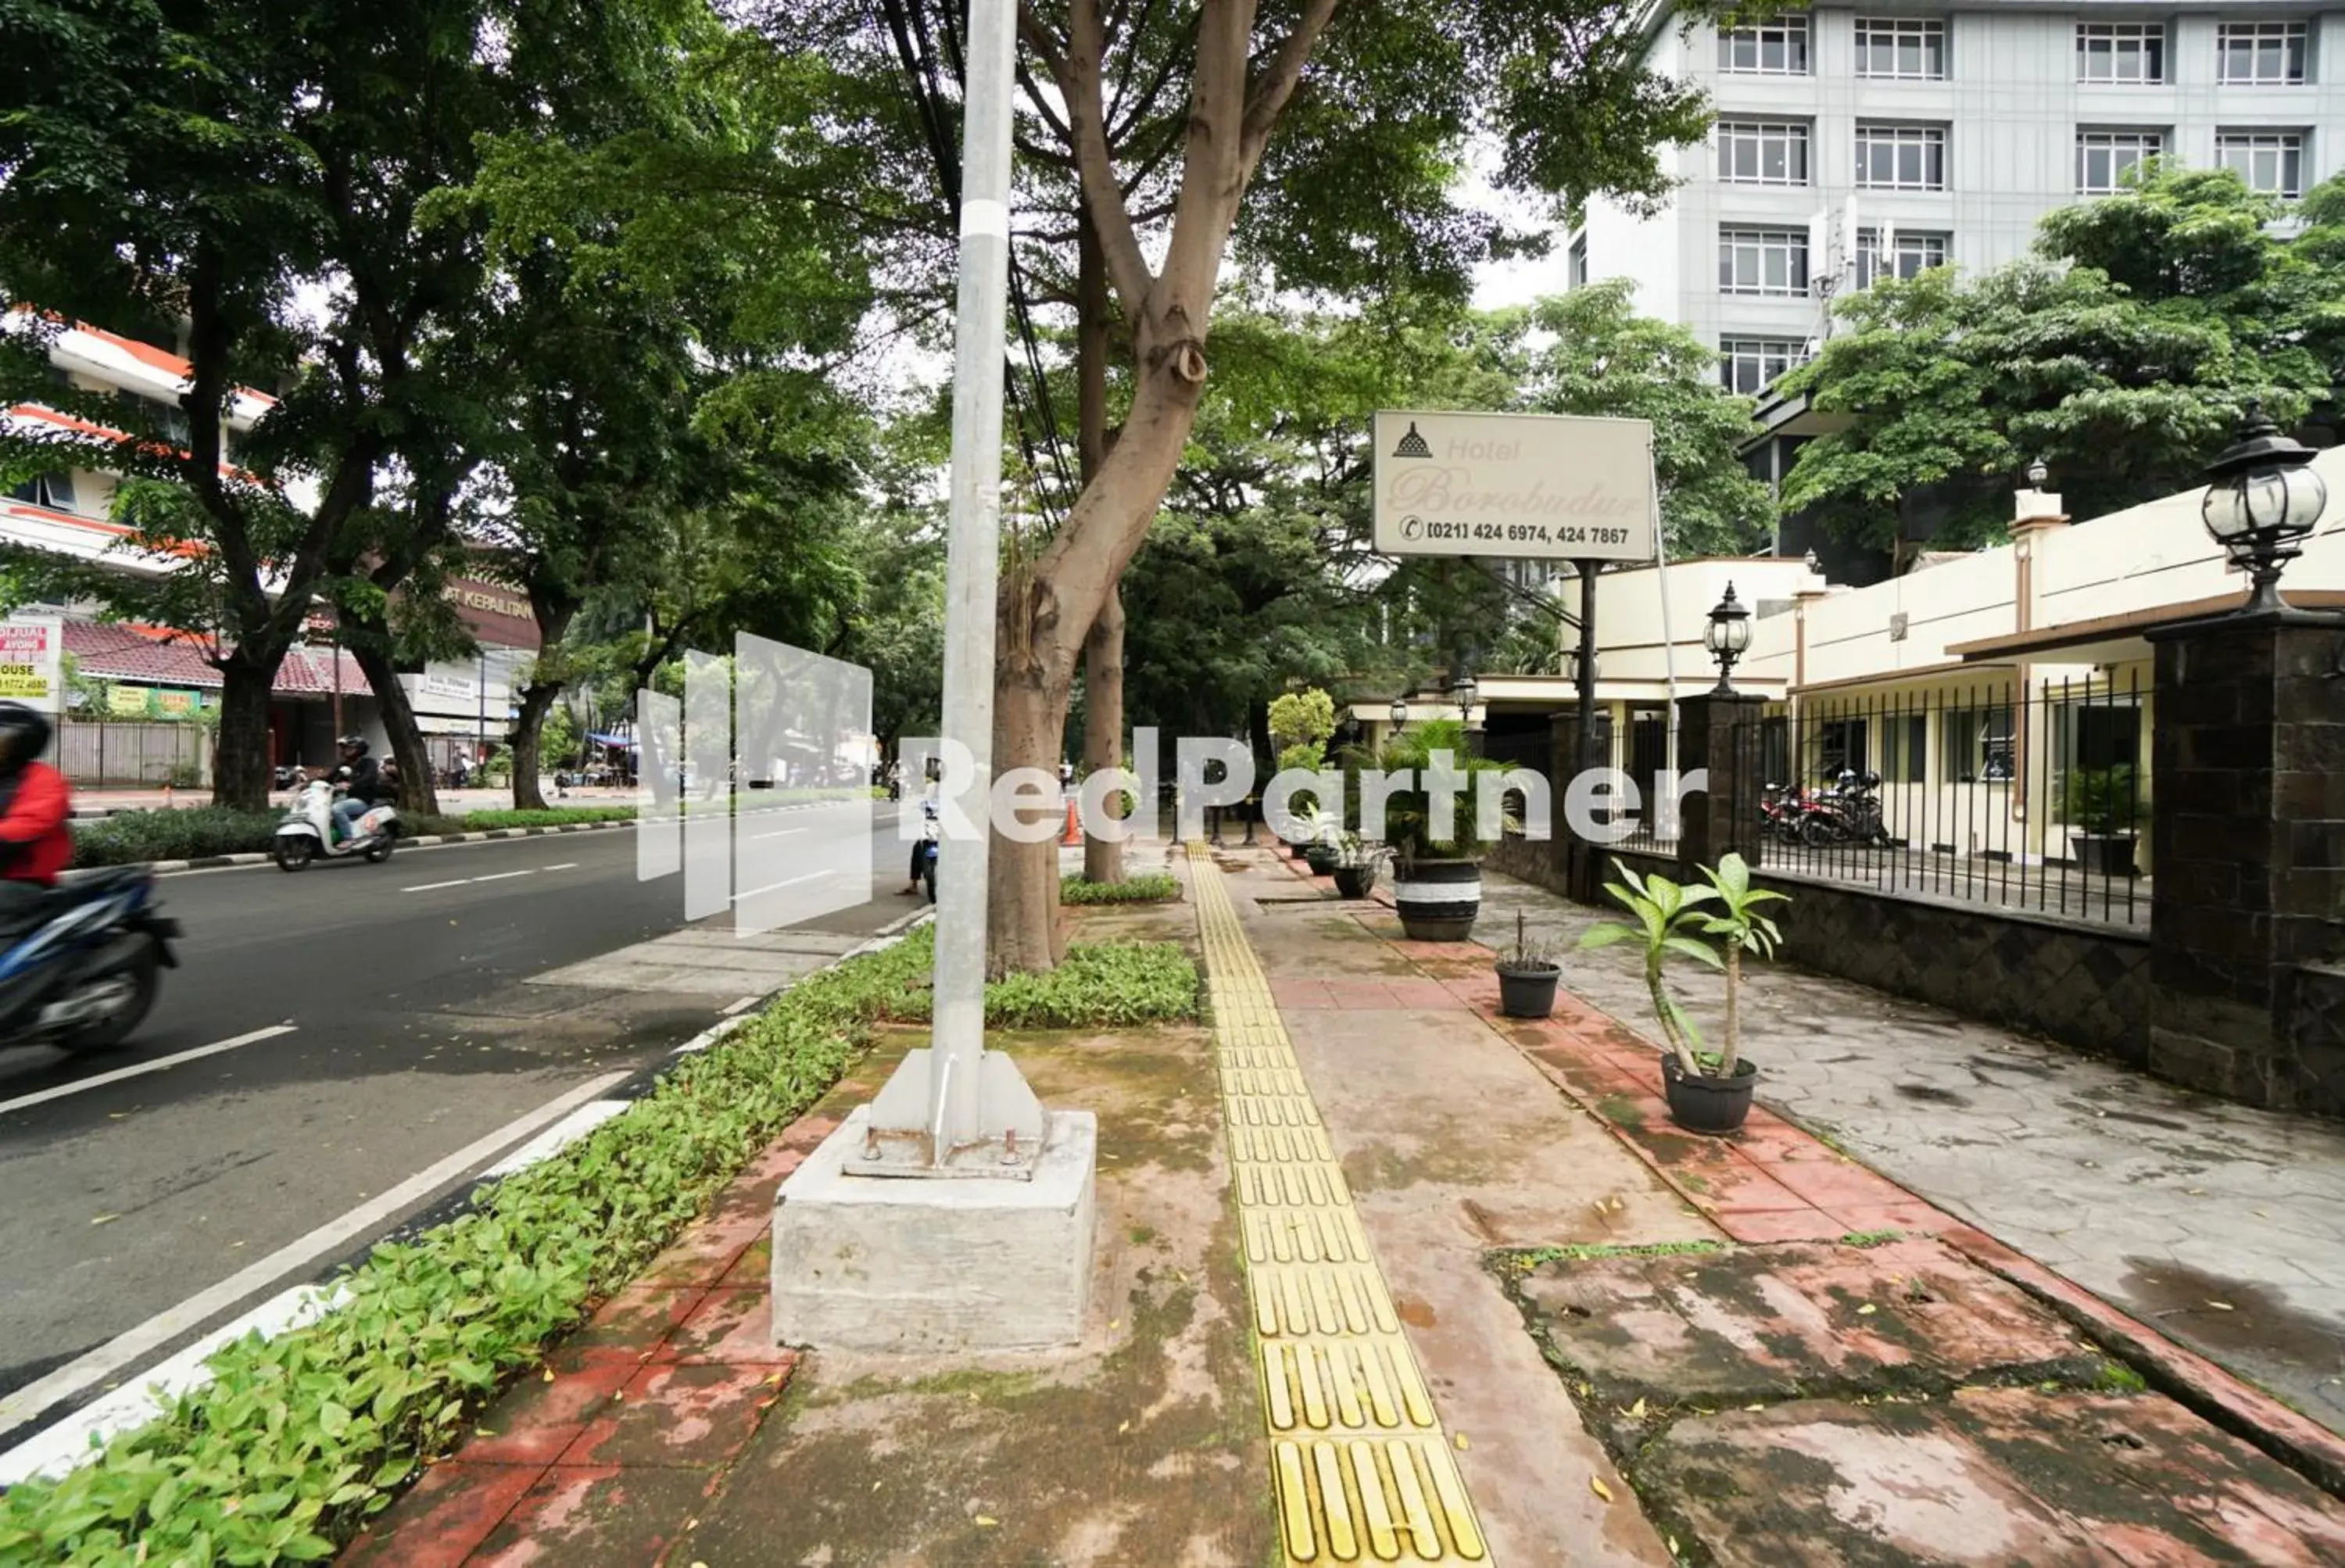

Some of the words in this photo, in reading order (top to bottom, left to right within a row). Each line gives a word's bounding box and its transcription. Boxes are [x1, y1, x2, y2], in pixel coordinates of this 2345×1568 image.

[1447, 438, 1521, 460] Hotel
[1386, 464, 1642, 517] Borobudur
[1473, 523, 1503, 540] 424
[1508, 524, 1552, 545] 6974,
[1556, 526, 1586, 543] 424
[1591, 528, 1630, 545] 7867
[464, 591, 533, 620] KEPAILITAN
